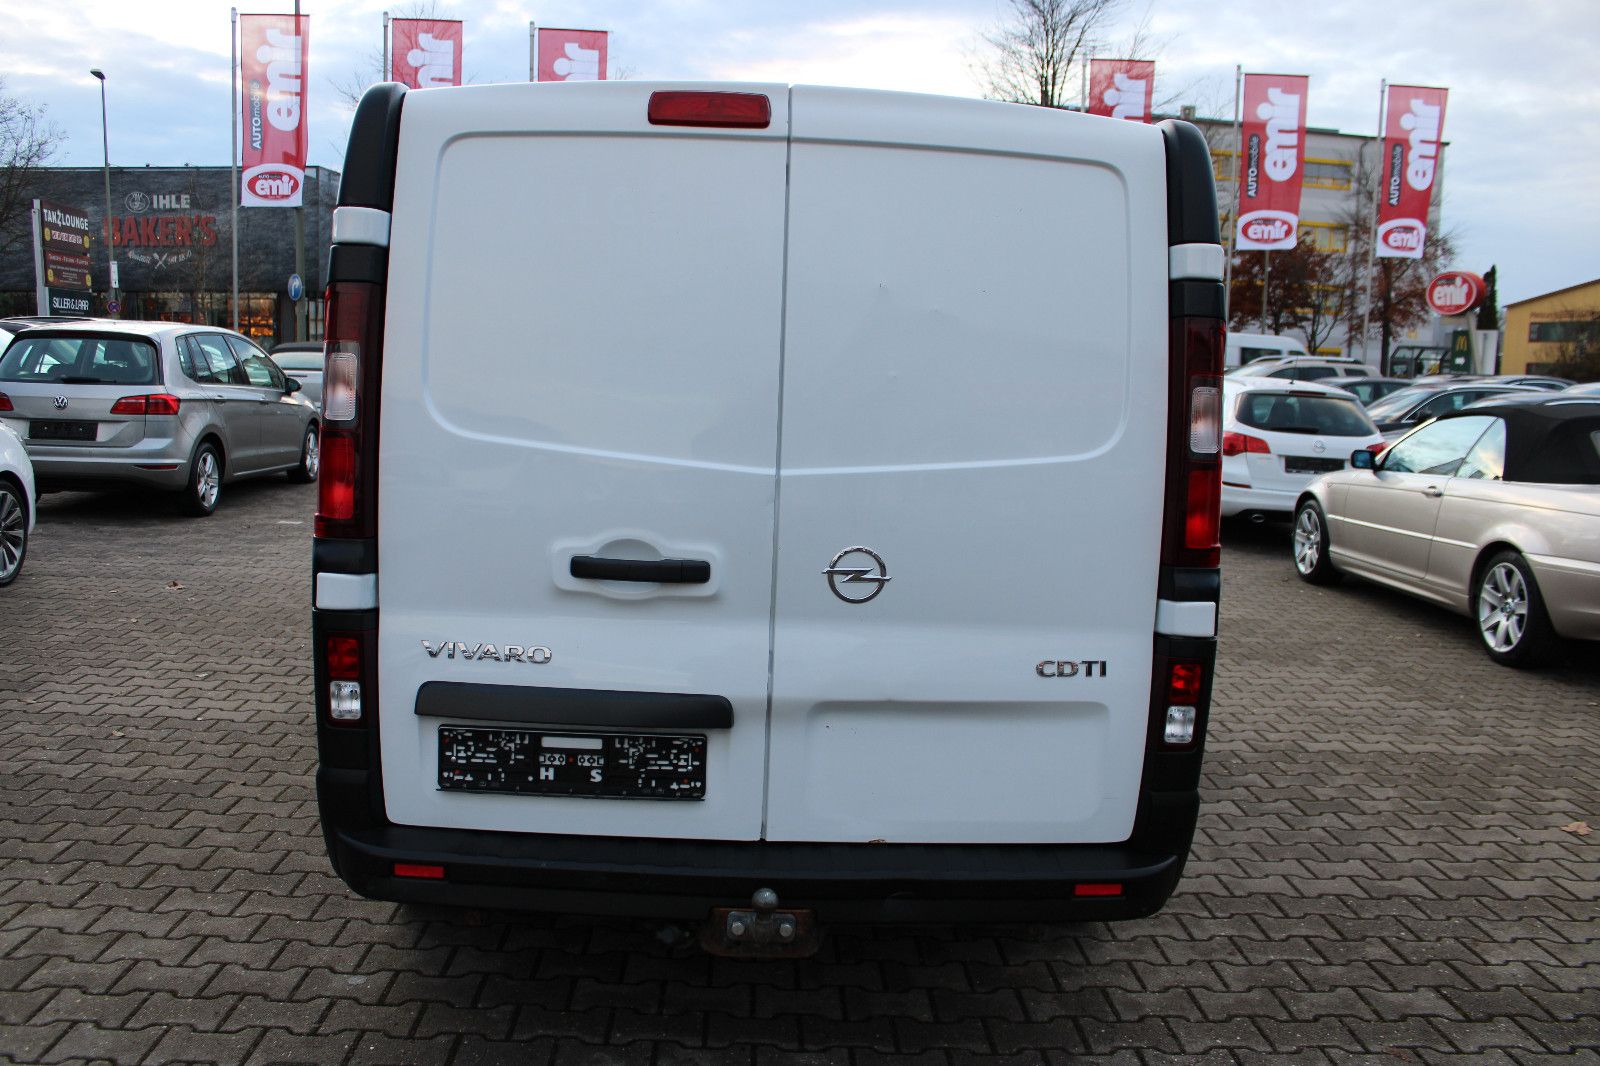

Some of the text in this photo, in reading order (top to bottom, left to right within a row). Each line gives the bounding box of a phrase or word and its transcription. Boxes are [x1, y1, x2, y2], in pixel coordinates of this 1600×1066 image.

[553, 43, 599, 80] ir
[257, 28, 302, 131] emir
[1256, 87, 1300, 182] emir
[1400, 98, 1440, 191] emir
[255, 174, 294, 196] emir
[152, 194, 191, 209] IHLE
[102, 214, 217, 247] BAKER'S
[1247, 220, 1289, 240] emir
[1433, 276, 1470, 306] emir
[421, 639, 552, 665] VIVARO
[1036, 660, 1107, 678] CDTI
